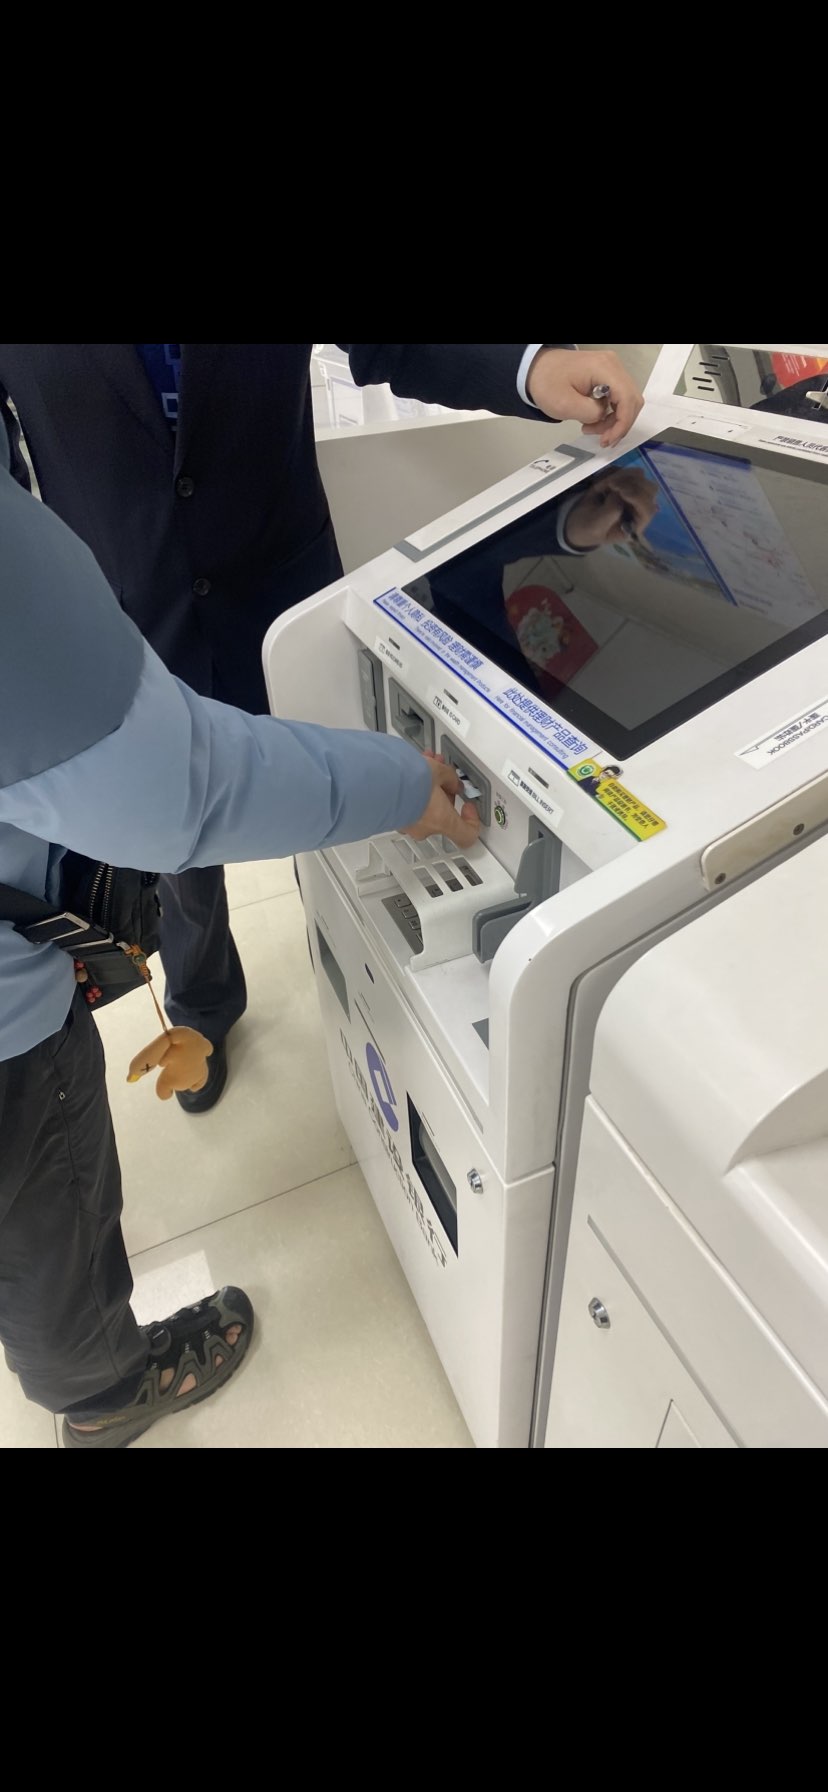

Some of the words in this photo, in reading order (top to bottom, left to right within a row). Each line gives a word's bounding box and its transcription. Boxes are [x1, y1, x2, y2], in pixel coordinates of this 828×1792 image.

[503, 688, 588, 755] 此处提供理财产品查询
[509, 708, 526, 722] financial
[523, 720, 549, 741] management
[547, 740, 569, 759] consulting
